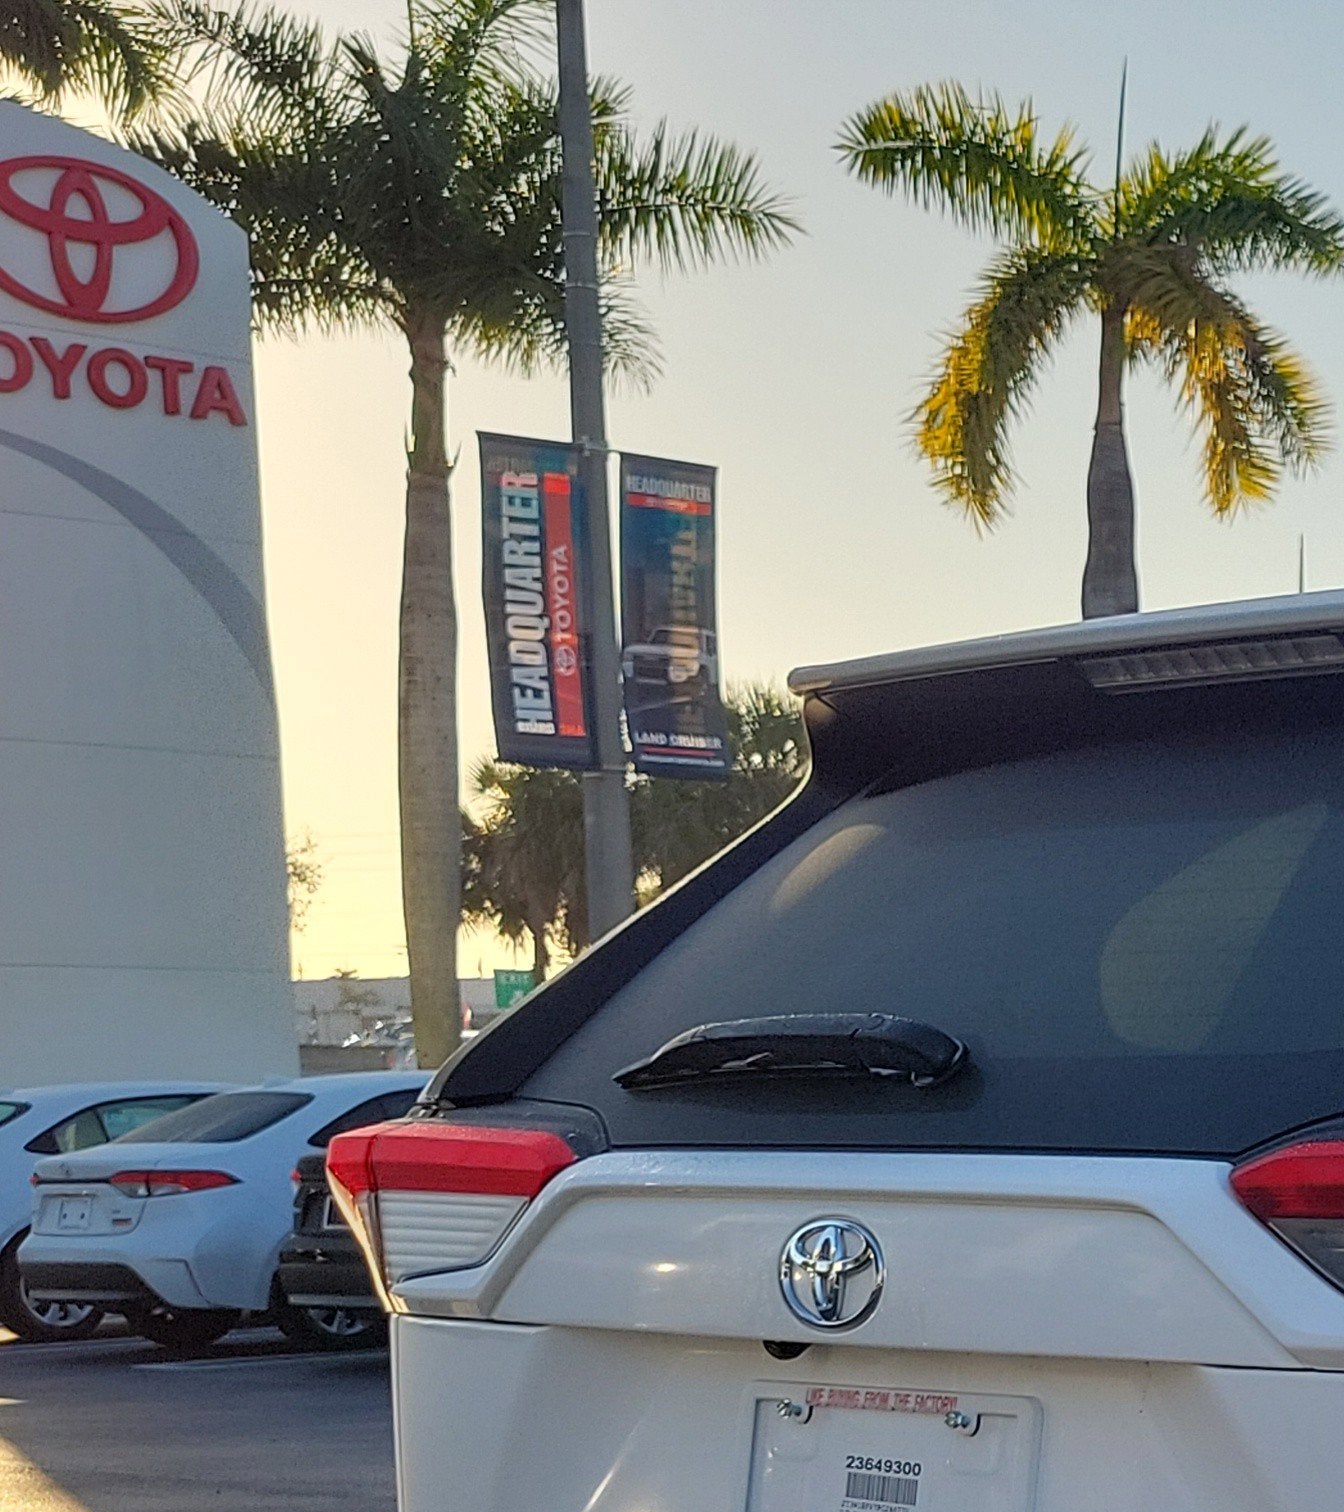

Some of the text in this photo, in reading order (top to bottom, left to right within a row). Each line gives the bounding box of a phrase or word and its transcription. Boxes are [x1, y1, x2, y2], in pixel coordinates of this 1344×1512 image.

[626, 475, 711, 503] HEADQUARTER
[502, 470, 556, 735] HEADQUARTER
[552, 545, 576, 641] TOYOTA
[635, 731, 667, 745] LAND
[846, 1455, 922, 1476] 23649300
